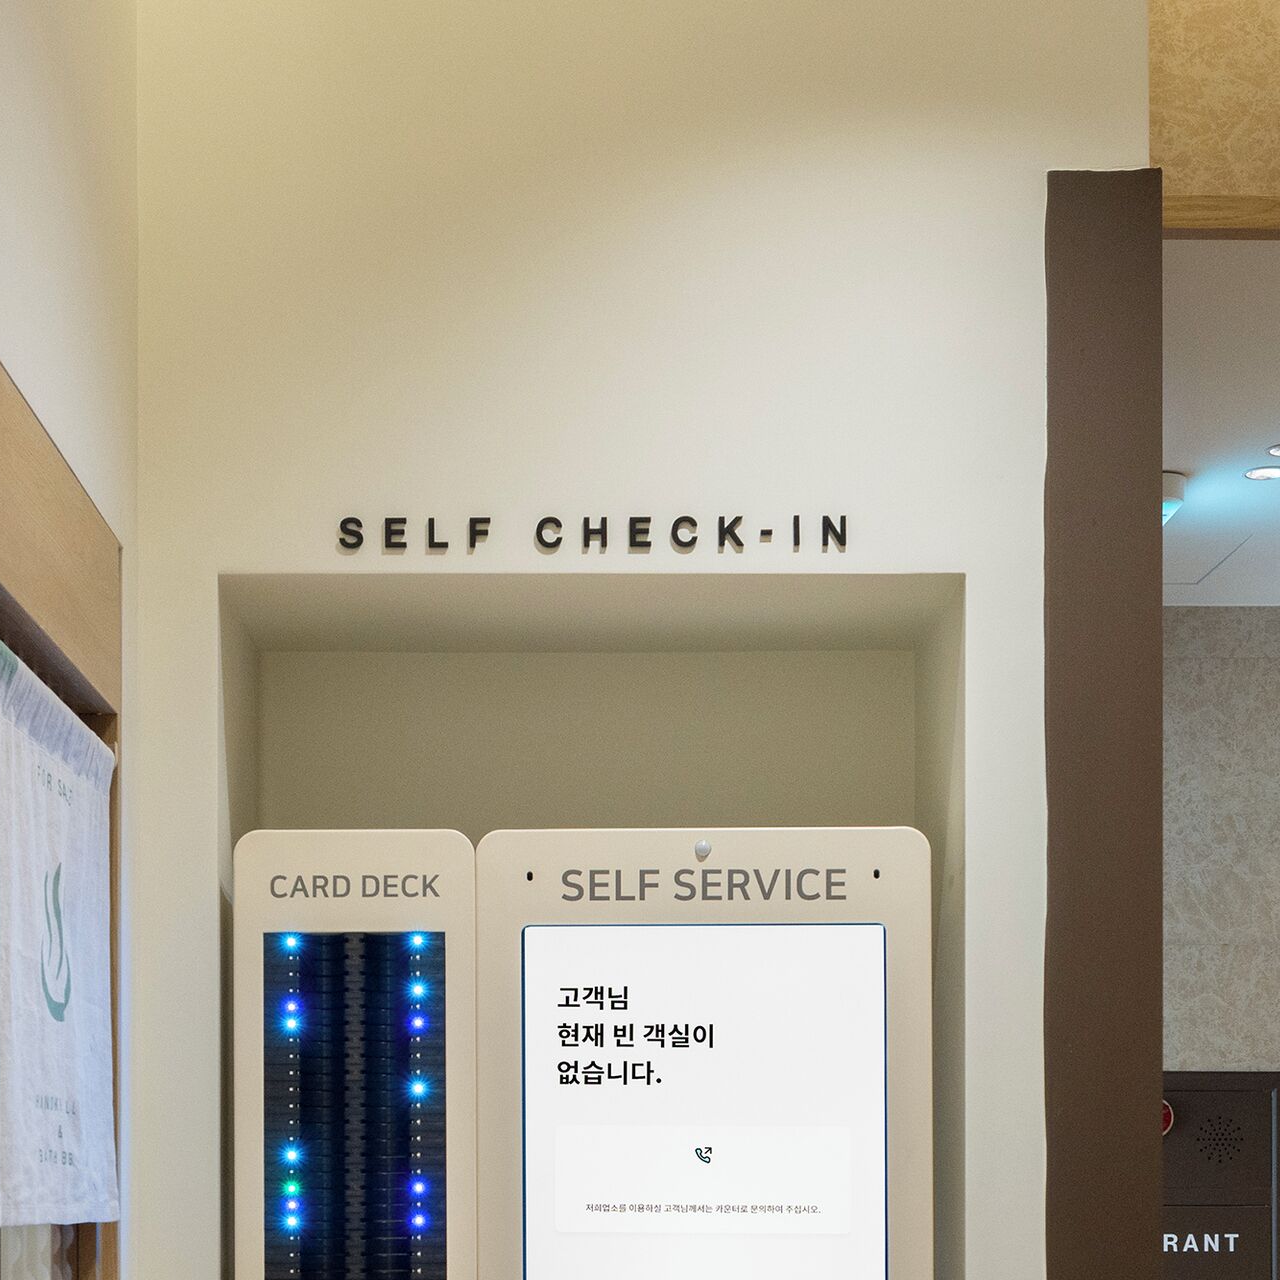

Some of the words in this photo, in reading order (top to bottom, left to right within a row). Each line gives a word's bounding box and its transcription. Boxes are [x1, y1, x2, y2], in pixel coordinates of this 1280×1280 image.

[338, 515, 491, 550] SELF
[535, 514, 847, 549] CHECK-IN
[270, 874, 351, 899] CARD
[361, 874, 440, 898] DECK
[561, 869, 660, 902] SELF
[673, 868, 847, 902] SERVICE
[557, 985, 628, 1011] 고객님
[557, 1022, 604, 1048] 현재
[613, 1023, 635, 1048] 빈
[643, 1023, 714, 1049] 객실이
[557, 1060, 662, 1086] 없습니다.
[750, 1204, 784, 1214] 문의하여
